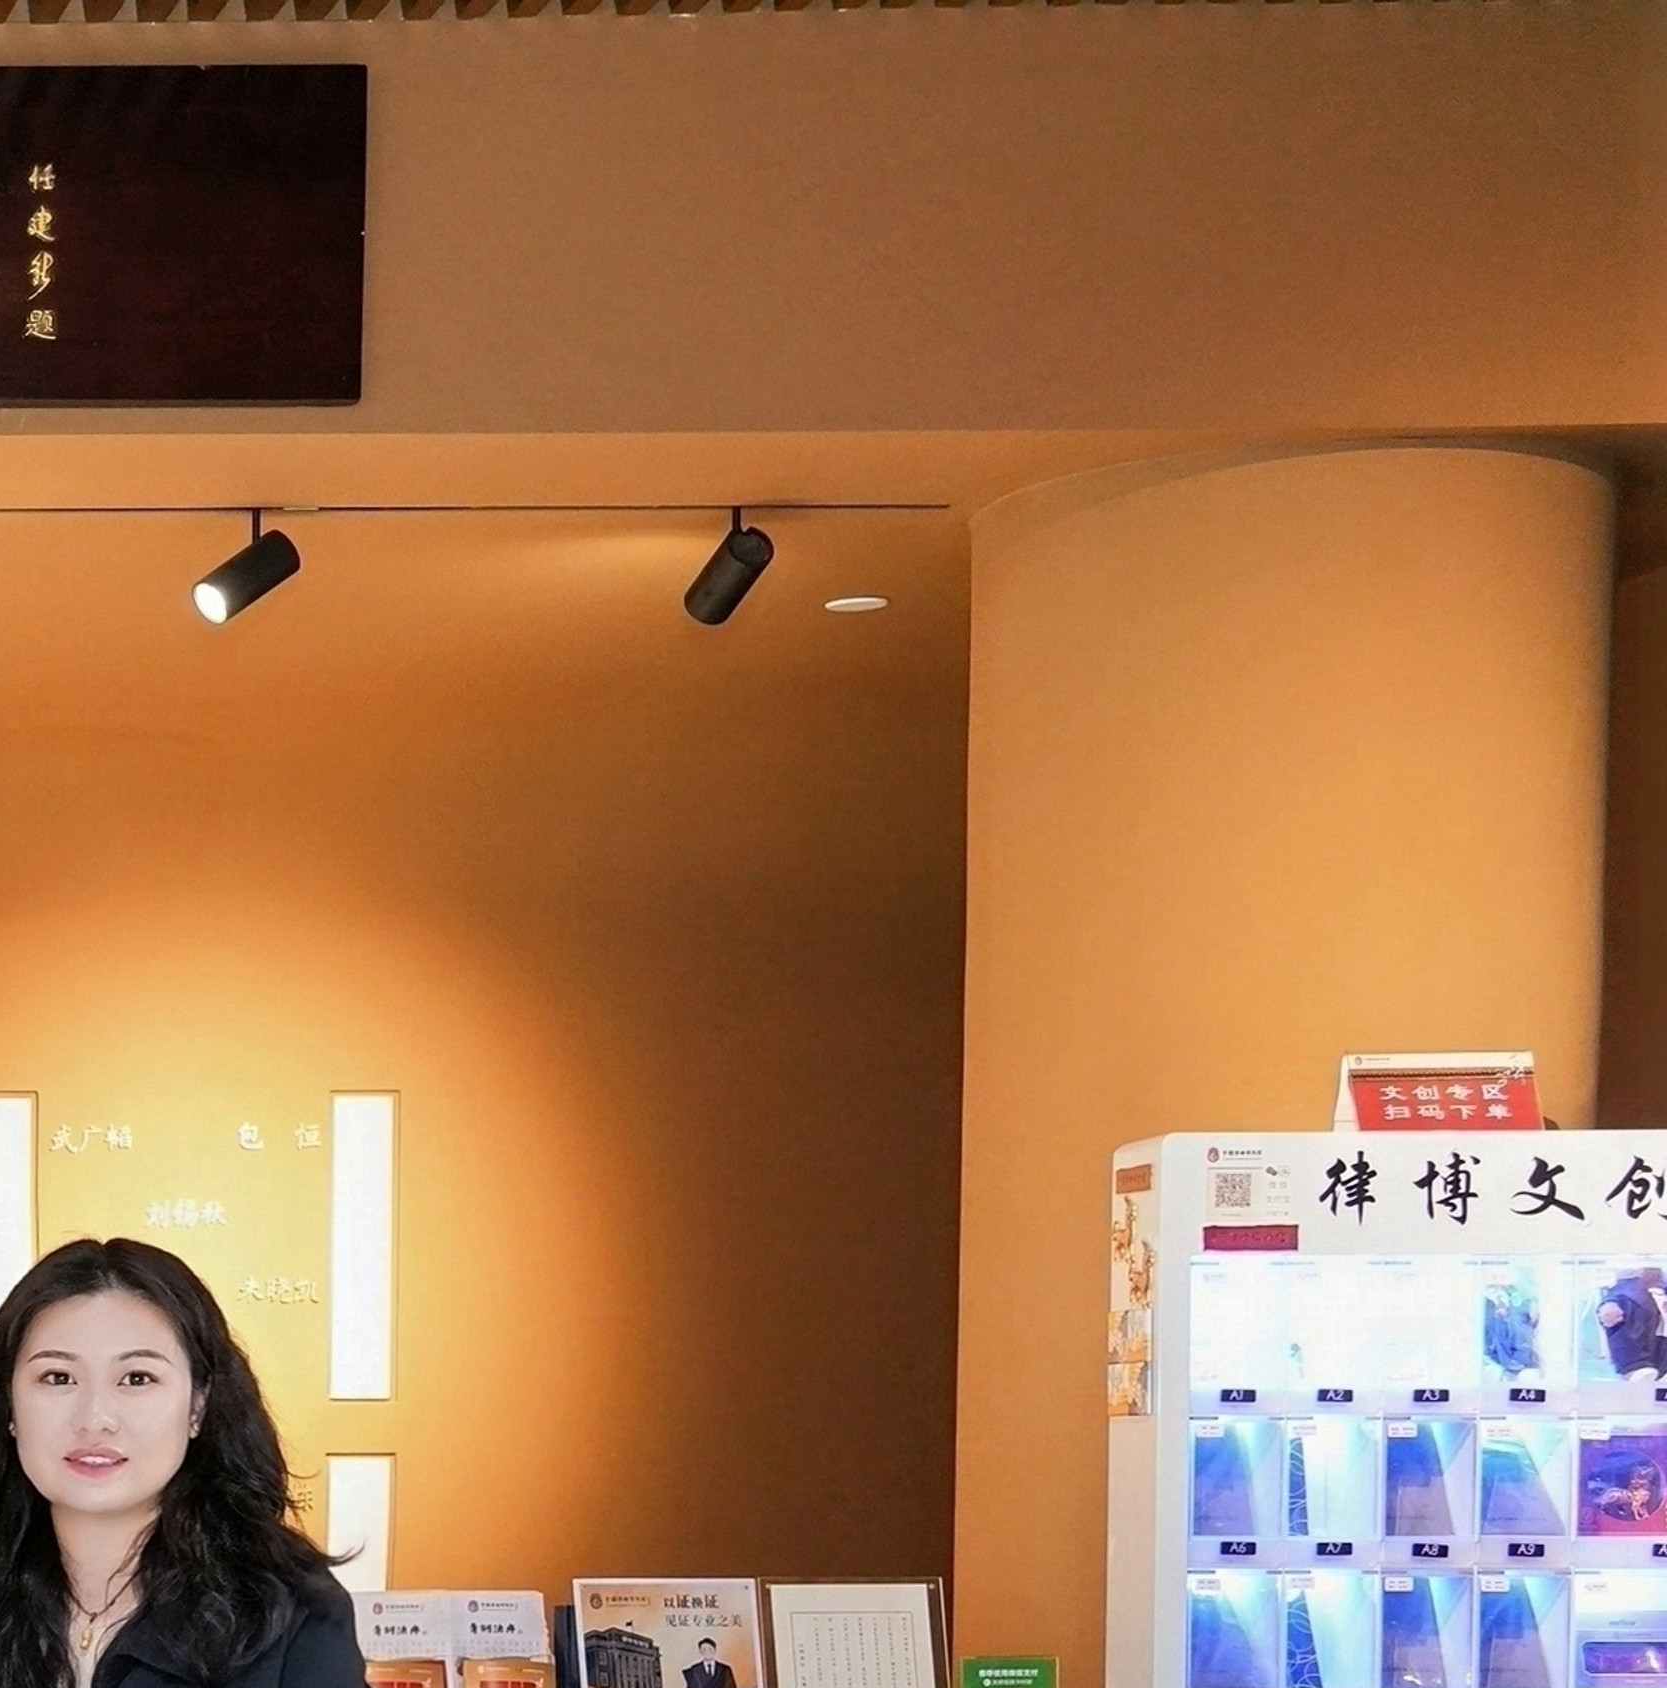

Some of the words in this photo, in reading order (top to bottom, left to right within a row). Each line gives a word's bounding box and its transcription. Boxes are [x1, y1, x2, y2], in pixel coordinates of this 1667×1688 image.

[1380, 1083, 1509, 1101] 文创专区
[1384, 1103, 1513, 1121] 扫码下单
[1230, 1390, 1243, 1401] A1
[1327, 1390, 1344, 1401] A2
[1423, 1390, 1440, 1401] A3
[1519, 1390, 1535, 1401] A4
[1230, 1542, 1246, 1554] A6
[1326, 1543, 1342, 1554] A7
[1421, 1544, 1439, 1556] A8
[1517, 1544, 1535, 1556] A9
